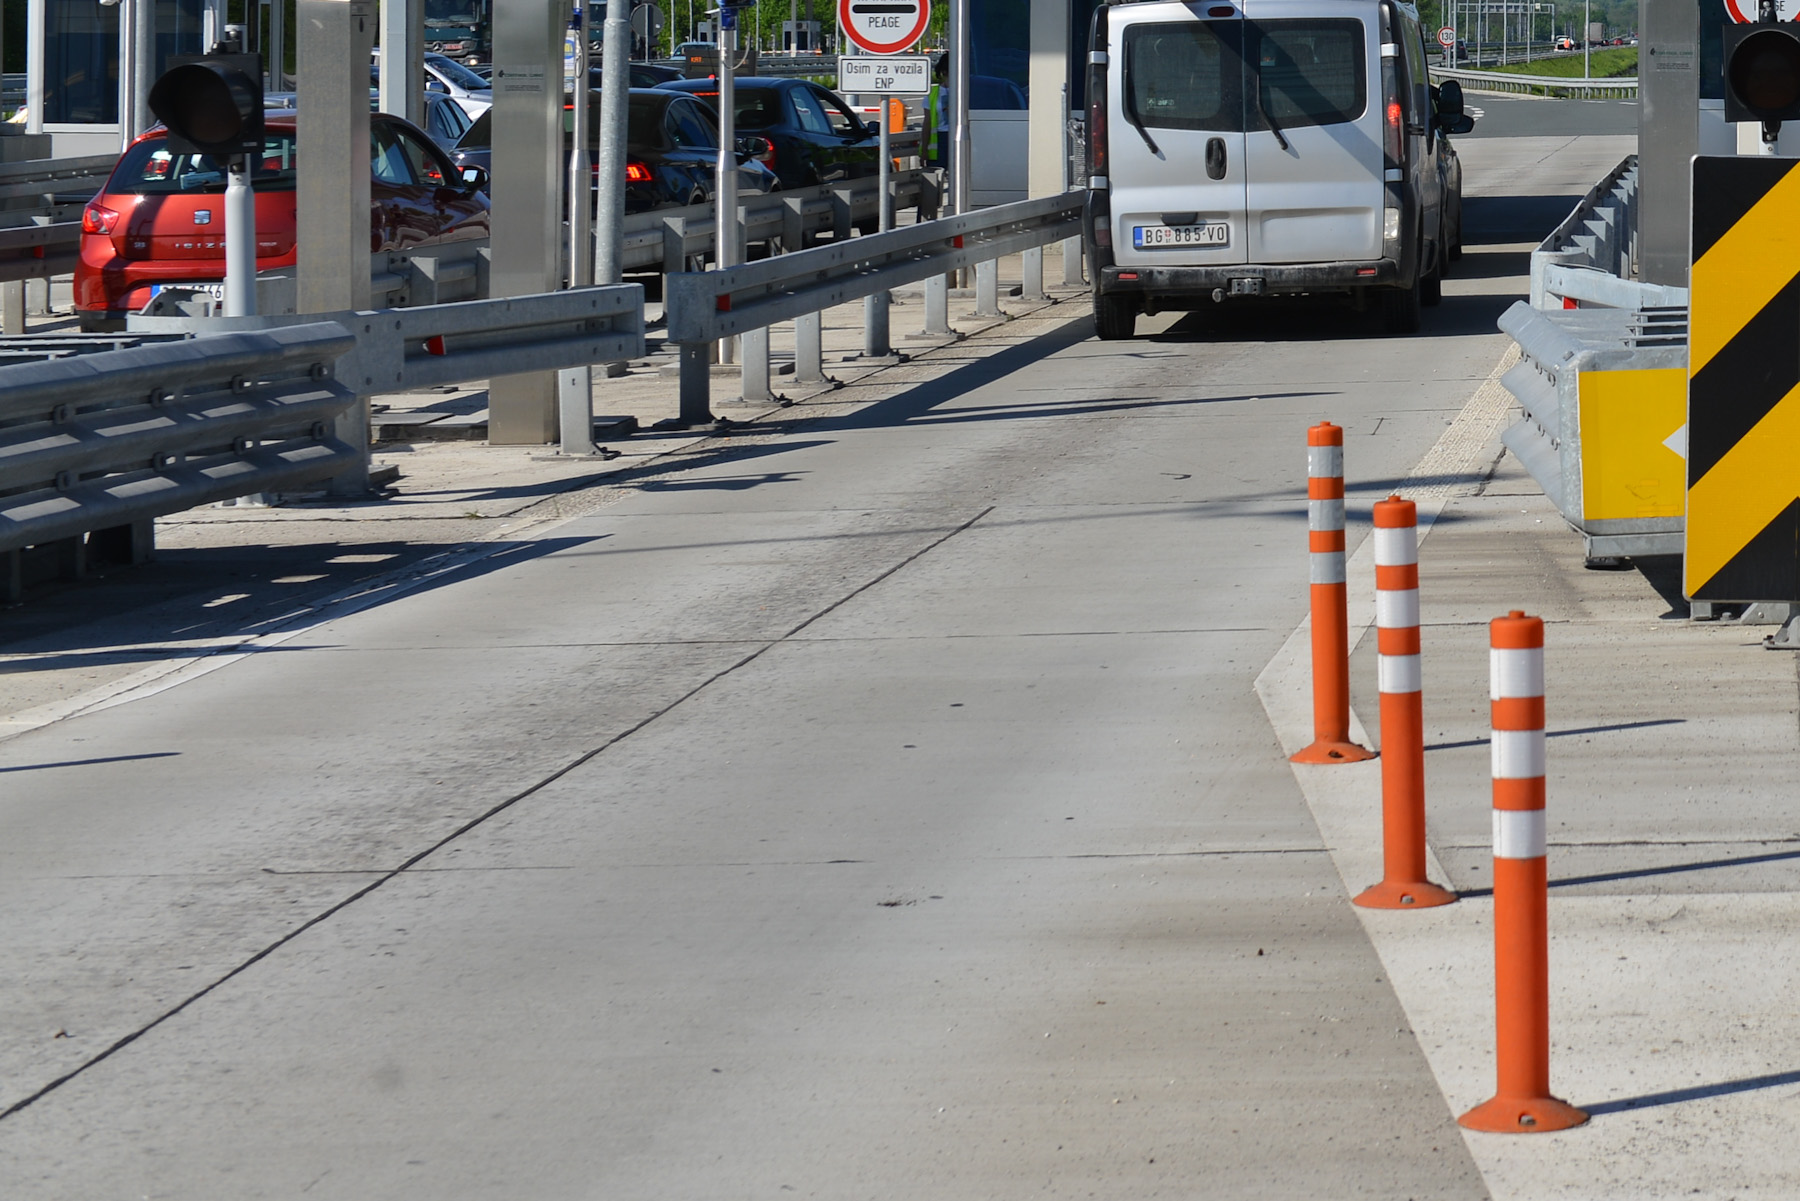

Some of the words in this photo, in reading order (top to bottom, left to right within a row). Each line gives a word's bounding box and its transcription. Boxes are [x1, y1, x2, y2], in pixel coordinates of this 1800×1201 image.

[868, 16, 901, 28] PEAGE
[1441, 32, 1454, 41] 130
[846, 62, 871, 74] Osim
[876, 65, 889, 74] za
[895, 63, 923, 74] vozila
[875, 77, 895, 89] ENP
[1145, 229, 1163, 244] BG
